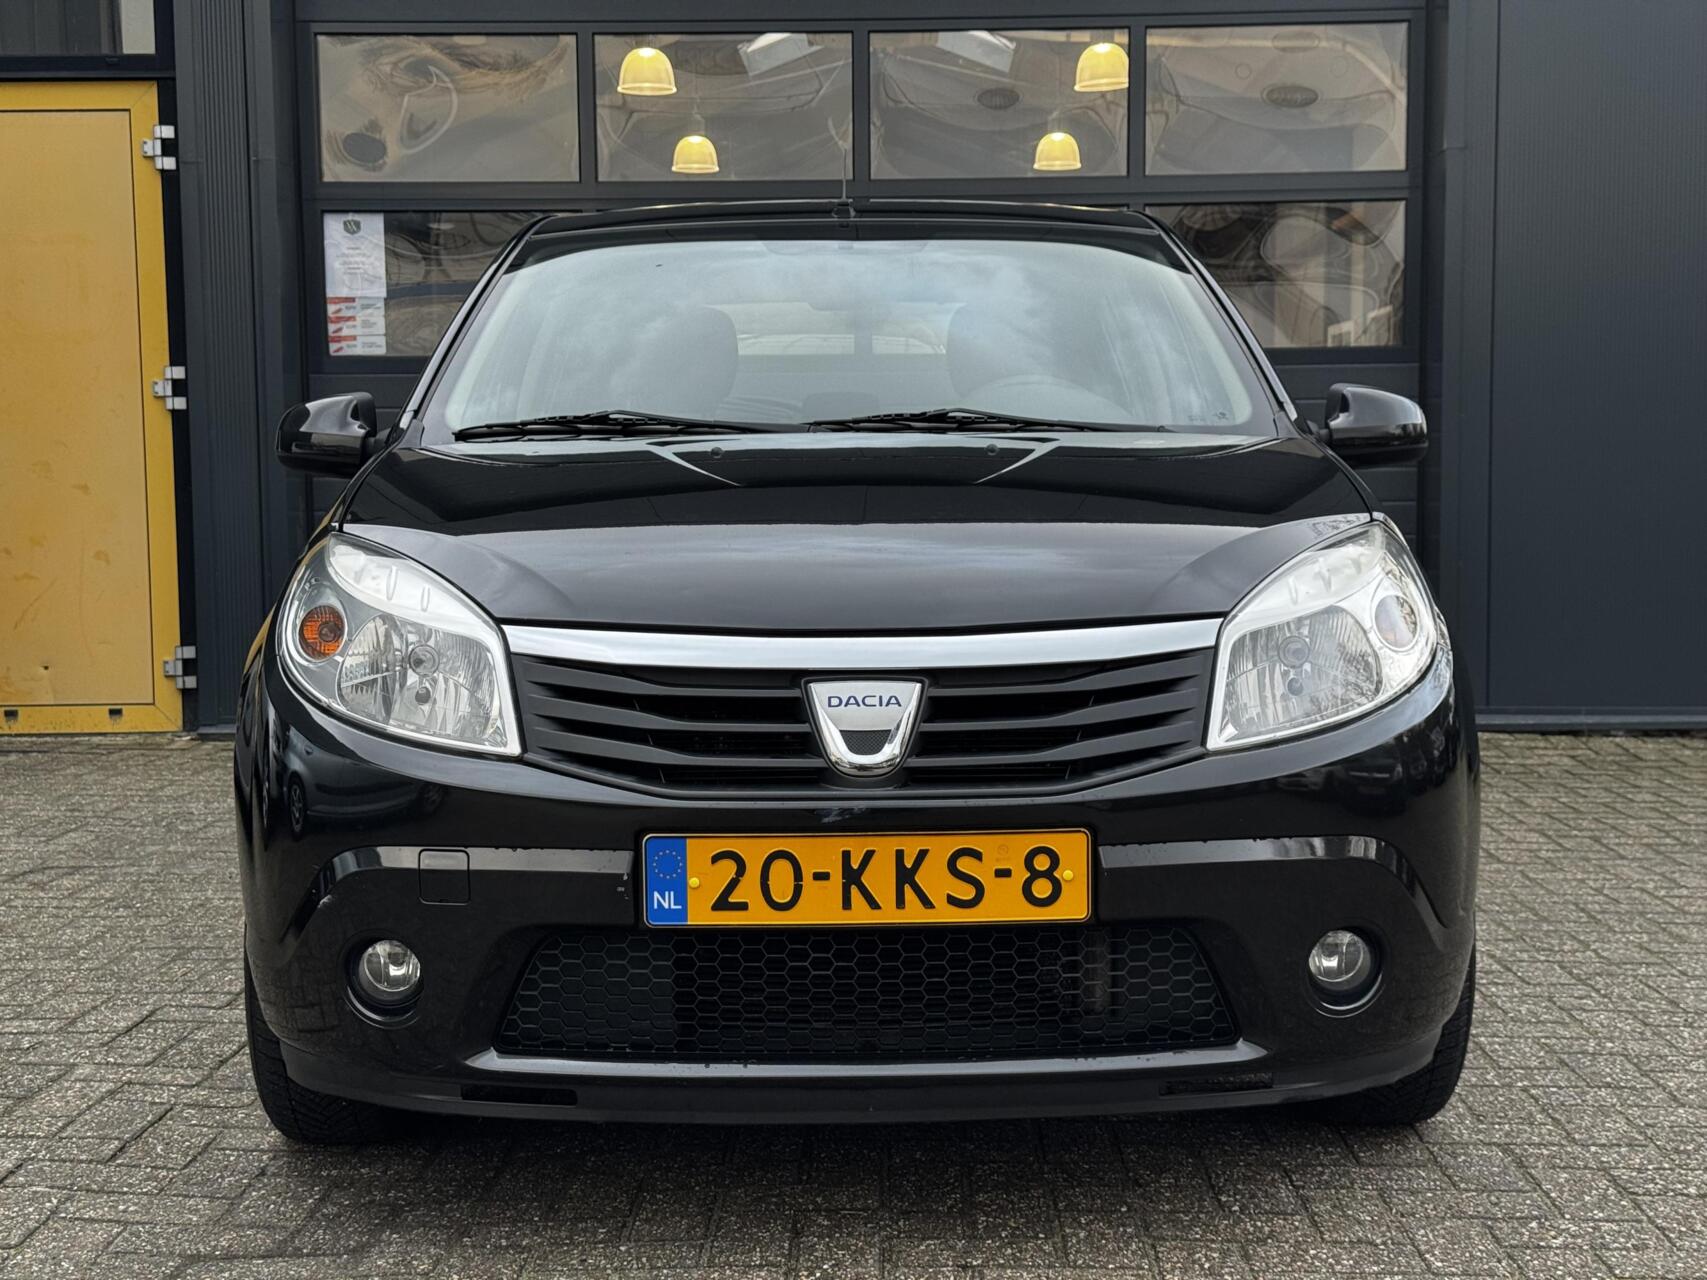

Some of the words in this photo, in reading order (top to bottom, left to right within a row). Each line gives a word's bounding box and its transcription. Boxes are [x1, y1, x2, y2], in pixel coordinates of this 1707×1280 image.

[827, 694, 902, 708] DACIA
[710, 844, 1063, 912] 20-KKS-8
[653, 890, 682, 910] NL
